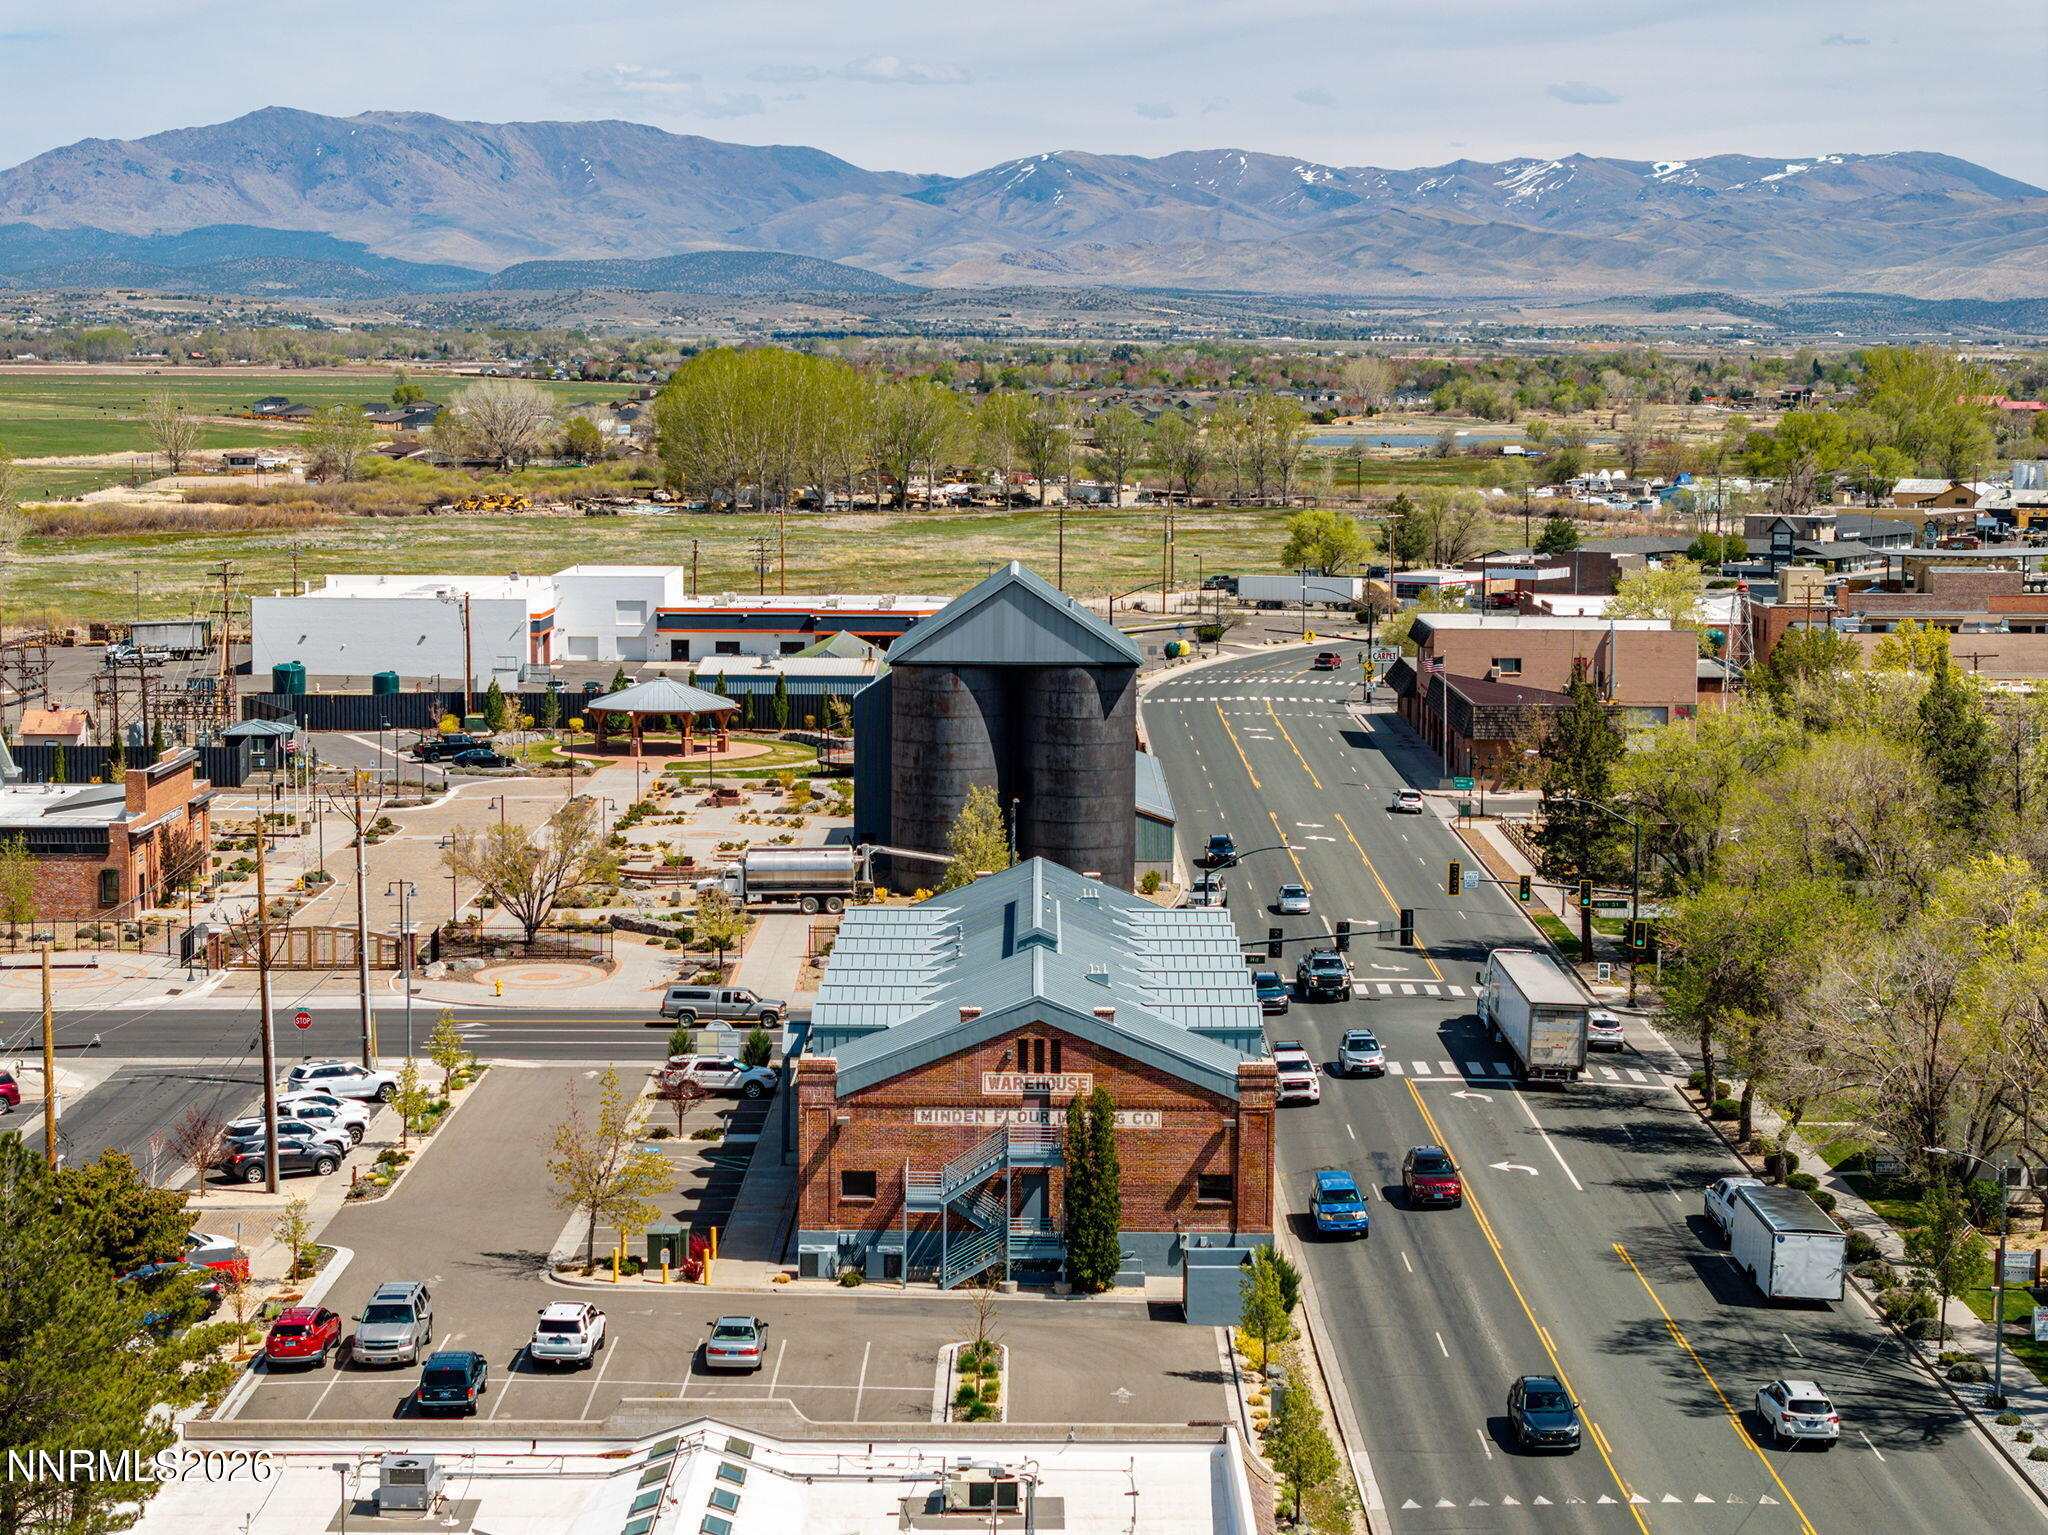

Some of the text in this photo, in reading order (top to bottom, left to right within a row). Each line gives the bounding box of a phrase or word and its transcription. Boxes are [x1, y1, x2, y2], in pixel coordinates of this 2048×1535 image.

[1372, 652, 1396, 660] CARPET
[295, 1017, 310, 1025] STOP
[988, 1076, 1090, 1092] WAREHOUSE
[921, 1110, 986, 1123] MINDEN
[994, 1111, 1050, 1124] FLOUR
[1132, 1112, 1158, 1125] CO.
